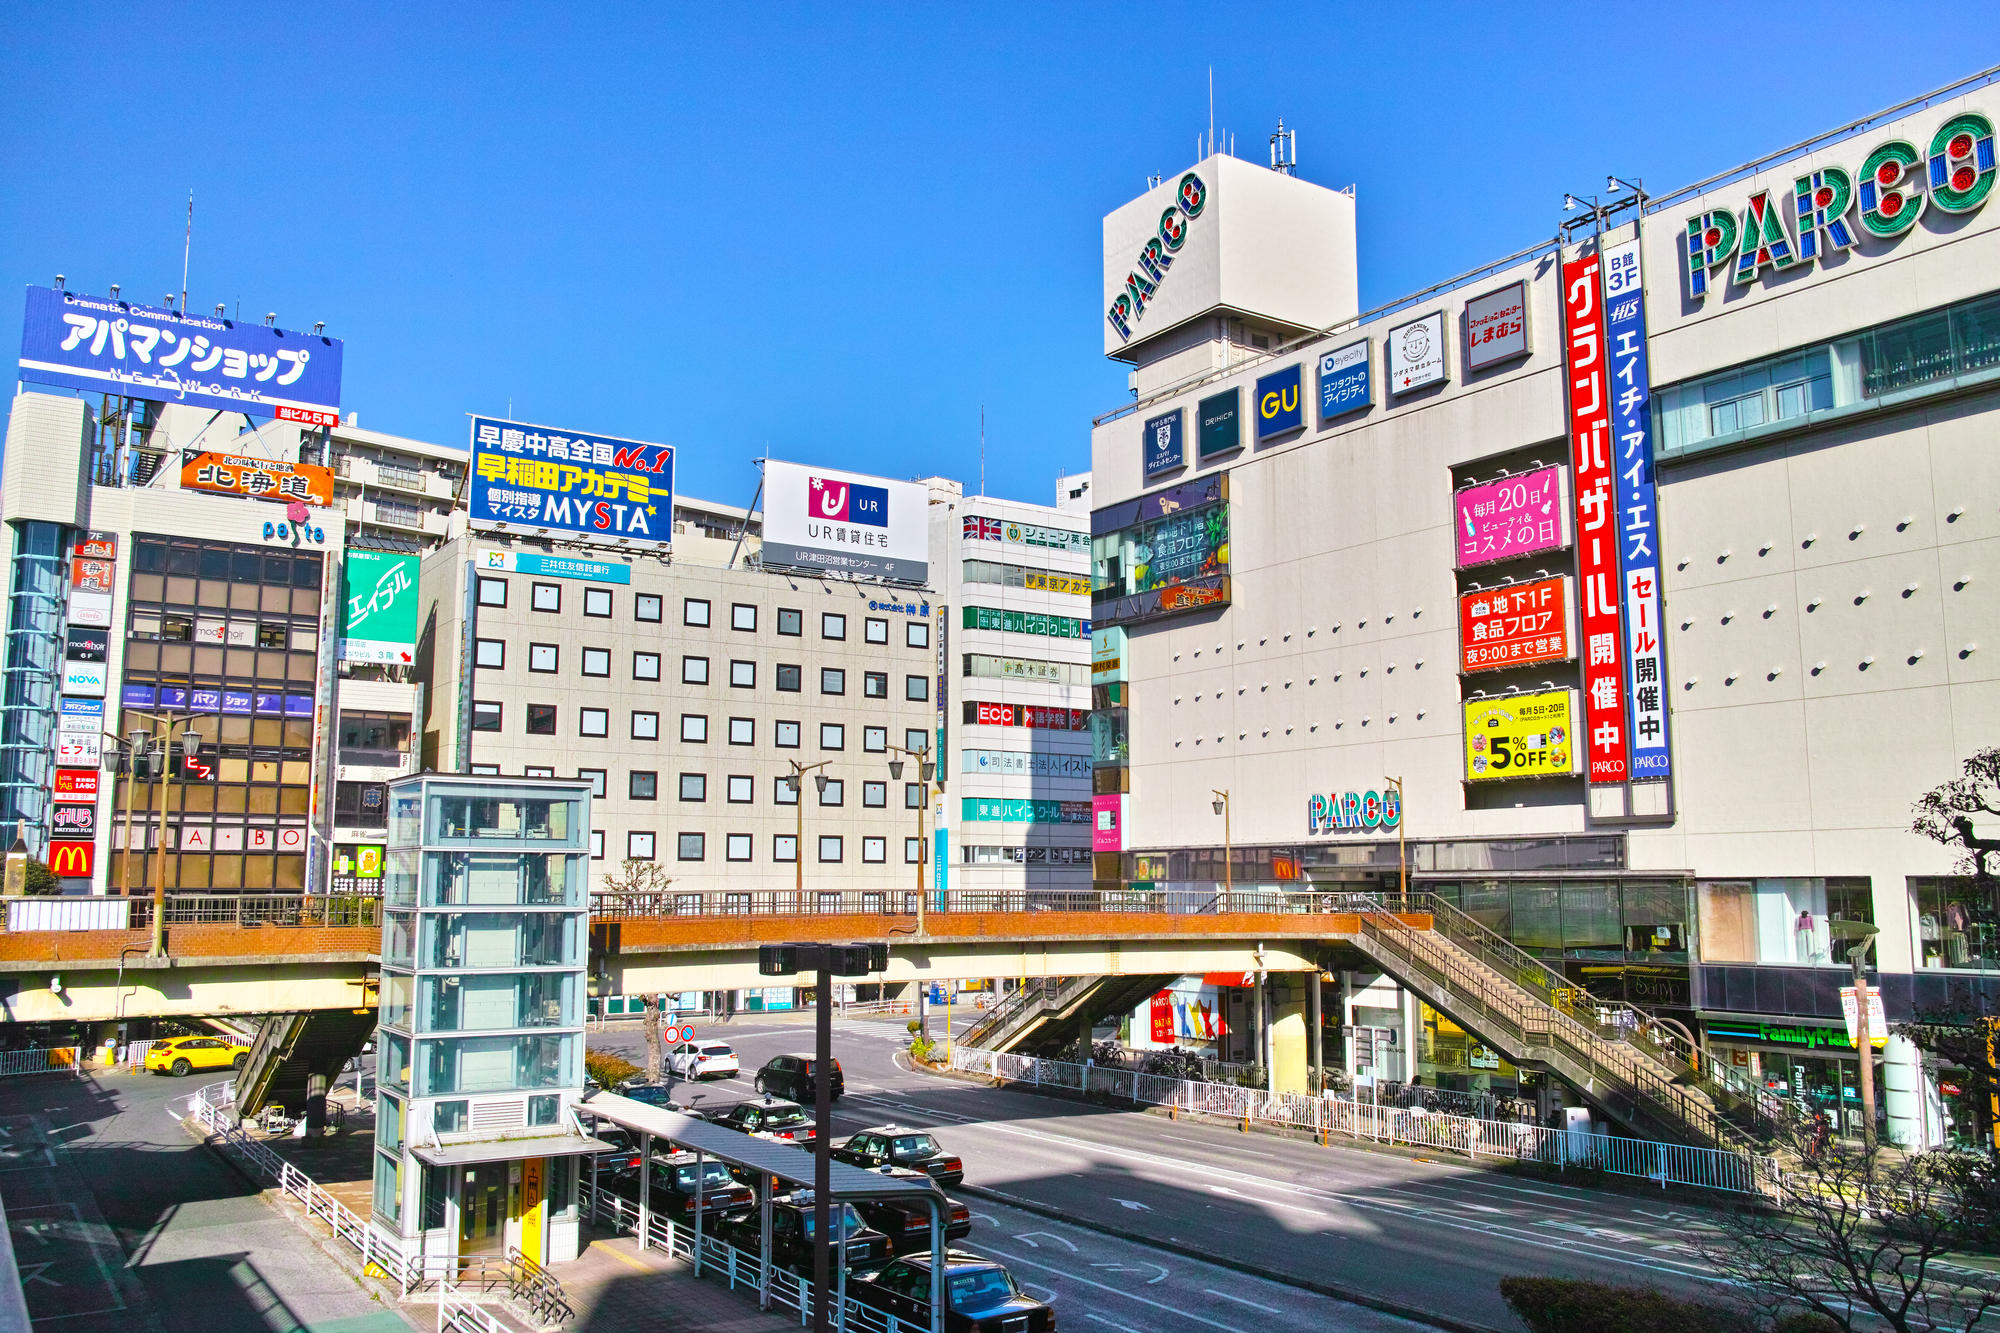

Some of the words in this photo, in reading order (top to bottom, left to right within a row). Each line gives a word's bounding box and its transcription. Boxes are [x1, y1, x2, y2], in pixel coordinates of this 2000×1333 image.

[1686, 111, 1999, 299] PARCO
[1108, 172, 1206, 343] PARCO
[1611, 252, 1634, 270] B館
[1609, 266, 1638, 291] 3F
[64, 296, 126, 314] Dramatic
[130, 306, 226, 331] Communication
[1470, 305, 1522, 328] ファッションセンター
[1470, 316, 1521, 348] しまむら
[61, 312, 310, 385] アパマンショップ
[1335, 348, 1363, 366] eyecity
[1324, 372, 1366, 391] コンタクトの
[1261, 384, 1298, 419] GU
[1324, 384, 1366, 407] アイシティ
[280, 407, 334, 426] 当ビル5階
[1205, 411, 1233, 426] ORIHICA
[184, 452, 197, 460] 7F
[477, 425, 614, 466] 早慶中高全国
[614, 445, 670, 473] No.1
[1148, 454, 1180, 469] ダイエットセンター
[198, 465, 314, 500] 北海道
[477, 452, 668, 504] 早稲田アカデミー
[488, 488, 542, 507] 個別指導
[860, 499, 878, 512] UR
[1474, 484, 1540, 518] 毎月20日
[488, 503, 540, 520] マイスタ
[543, 495, 650, 534] MYSTA
[90, 532, 103, 540] 7F
[808, 524, 888, 548] UR賃貸住宅
[1158, 534, 1204, 558] 食品フロア
[1464, 520, 1554, 554] コスメの日
[541, 558, 610, 574] 三井住友信託銀行
[796, 551, 877, 568] UR津田沼営業センター
[884, 563, 895, 571] 4F
[347, 566, 412, 624] エイブル
[1493, 588, 1552, 614] 地下1F
[992, 618, 1080, 638] 東進ハイスクール
[1472, 611, 1552, 641] 食品フロア
[378, 651, 394, 660] 3階
[1466, 636, 1562, 664] 夜9:00まで営業
[68, 675, 100, 684] NOVA
[980, 708, 1012, 721] ECC
[1026, 710, 1065, 724] 外語学院
[1071, 715, 1081, 725] 6F
[61, 745, 97, 755] ヒフ科
[1490, 736, 1526, 769] 5%
[1514, 751, 1546, 767] OFF
[187, 756, 214, 780] ヒフ科
[992, 757, 1090, 772] 司法書士法人イスト
[1592, 760, 1624, 773] PARCO
[1634, 755, 1668, 768] PARCO
[340, 767, 346, 779] 4F
[54, 808, 92, 827] HUB
[980, 804, 1060, 818] 東進ハイスクール
[1310, 789, 1400, 829] PARCO
[1016, 848, 1090, 860] テナント募集中
[1635, 976, 1680, 1001] Sanyo
[1154, 1018, 1172, 1028] BAZAR
[668, 1031, 676, 1040] 40
[1759, 1023, 1850, 1048] FamilyMar
